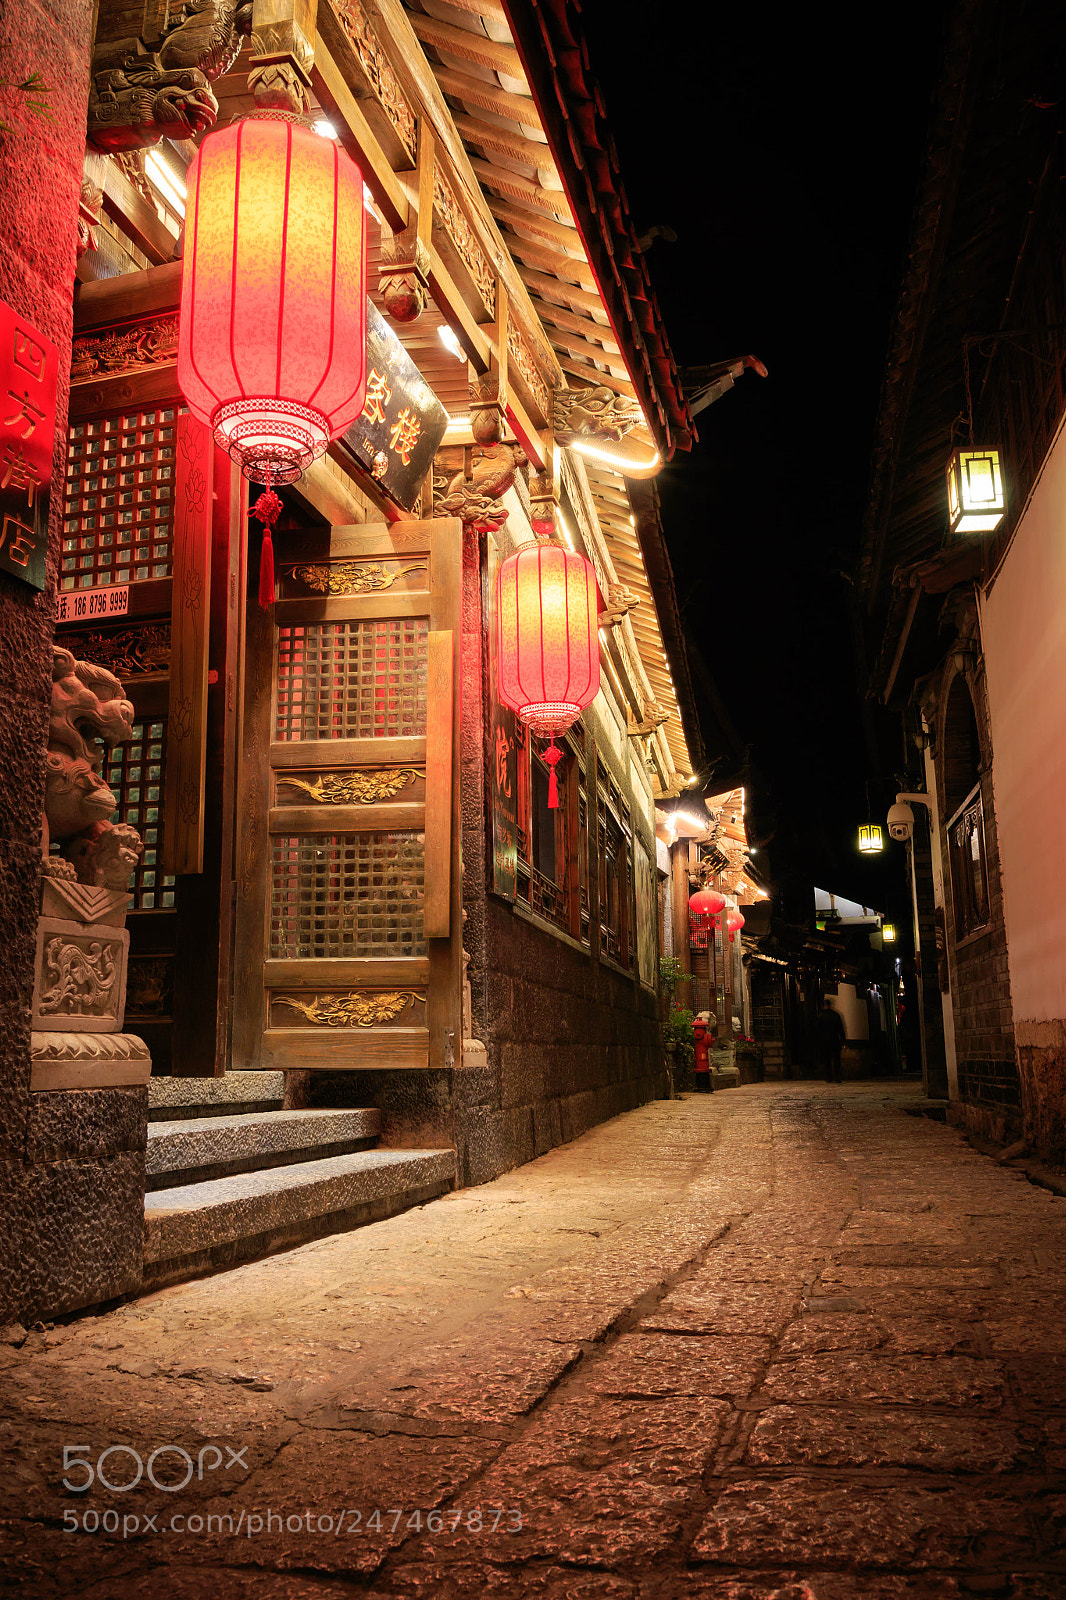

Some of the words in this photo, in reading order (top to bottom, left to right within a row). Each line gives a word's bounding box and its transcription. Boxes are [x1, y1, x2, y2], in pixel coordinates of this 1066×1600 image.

[0, 326, 47, 568] 四方街店
[74, 596, 87, 616] 186
[89, 593, 107, 614] 8796
[109, 590, 127, 612] 9999
